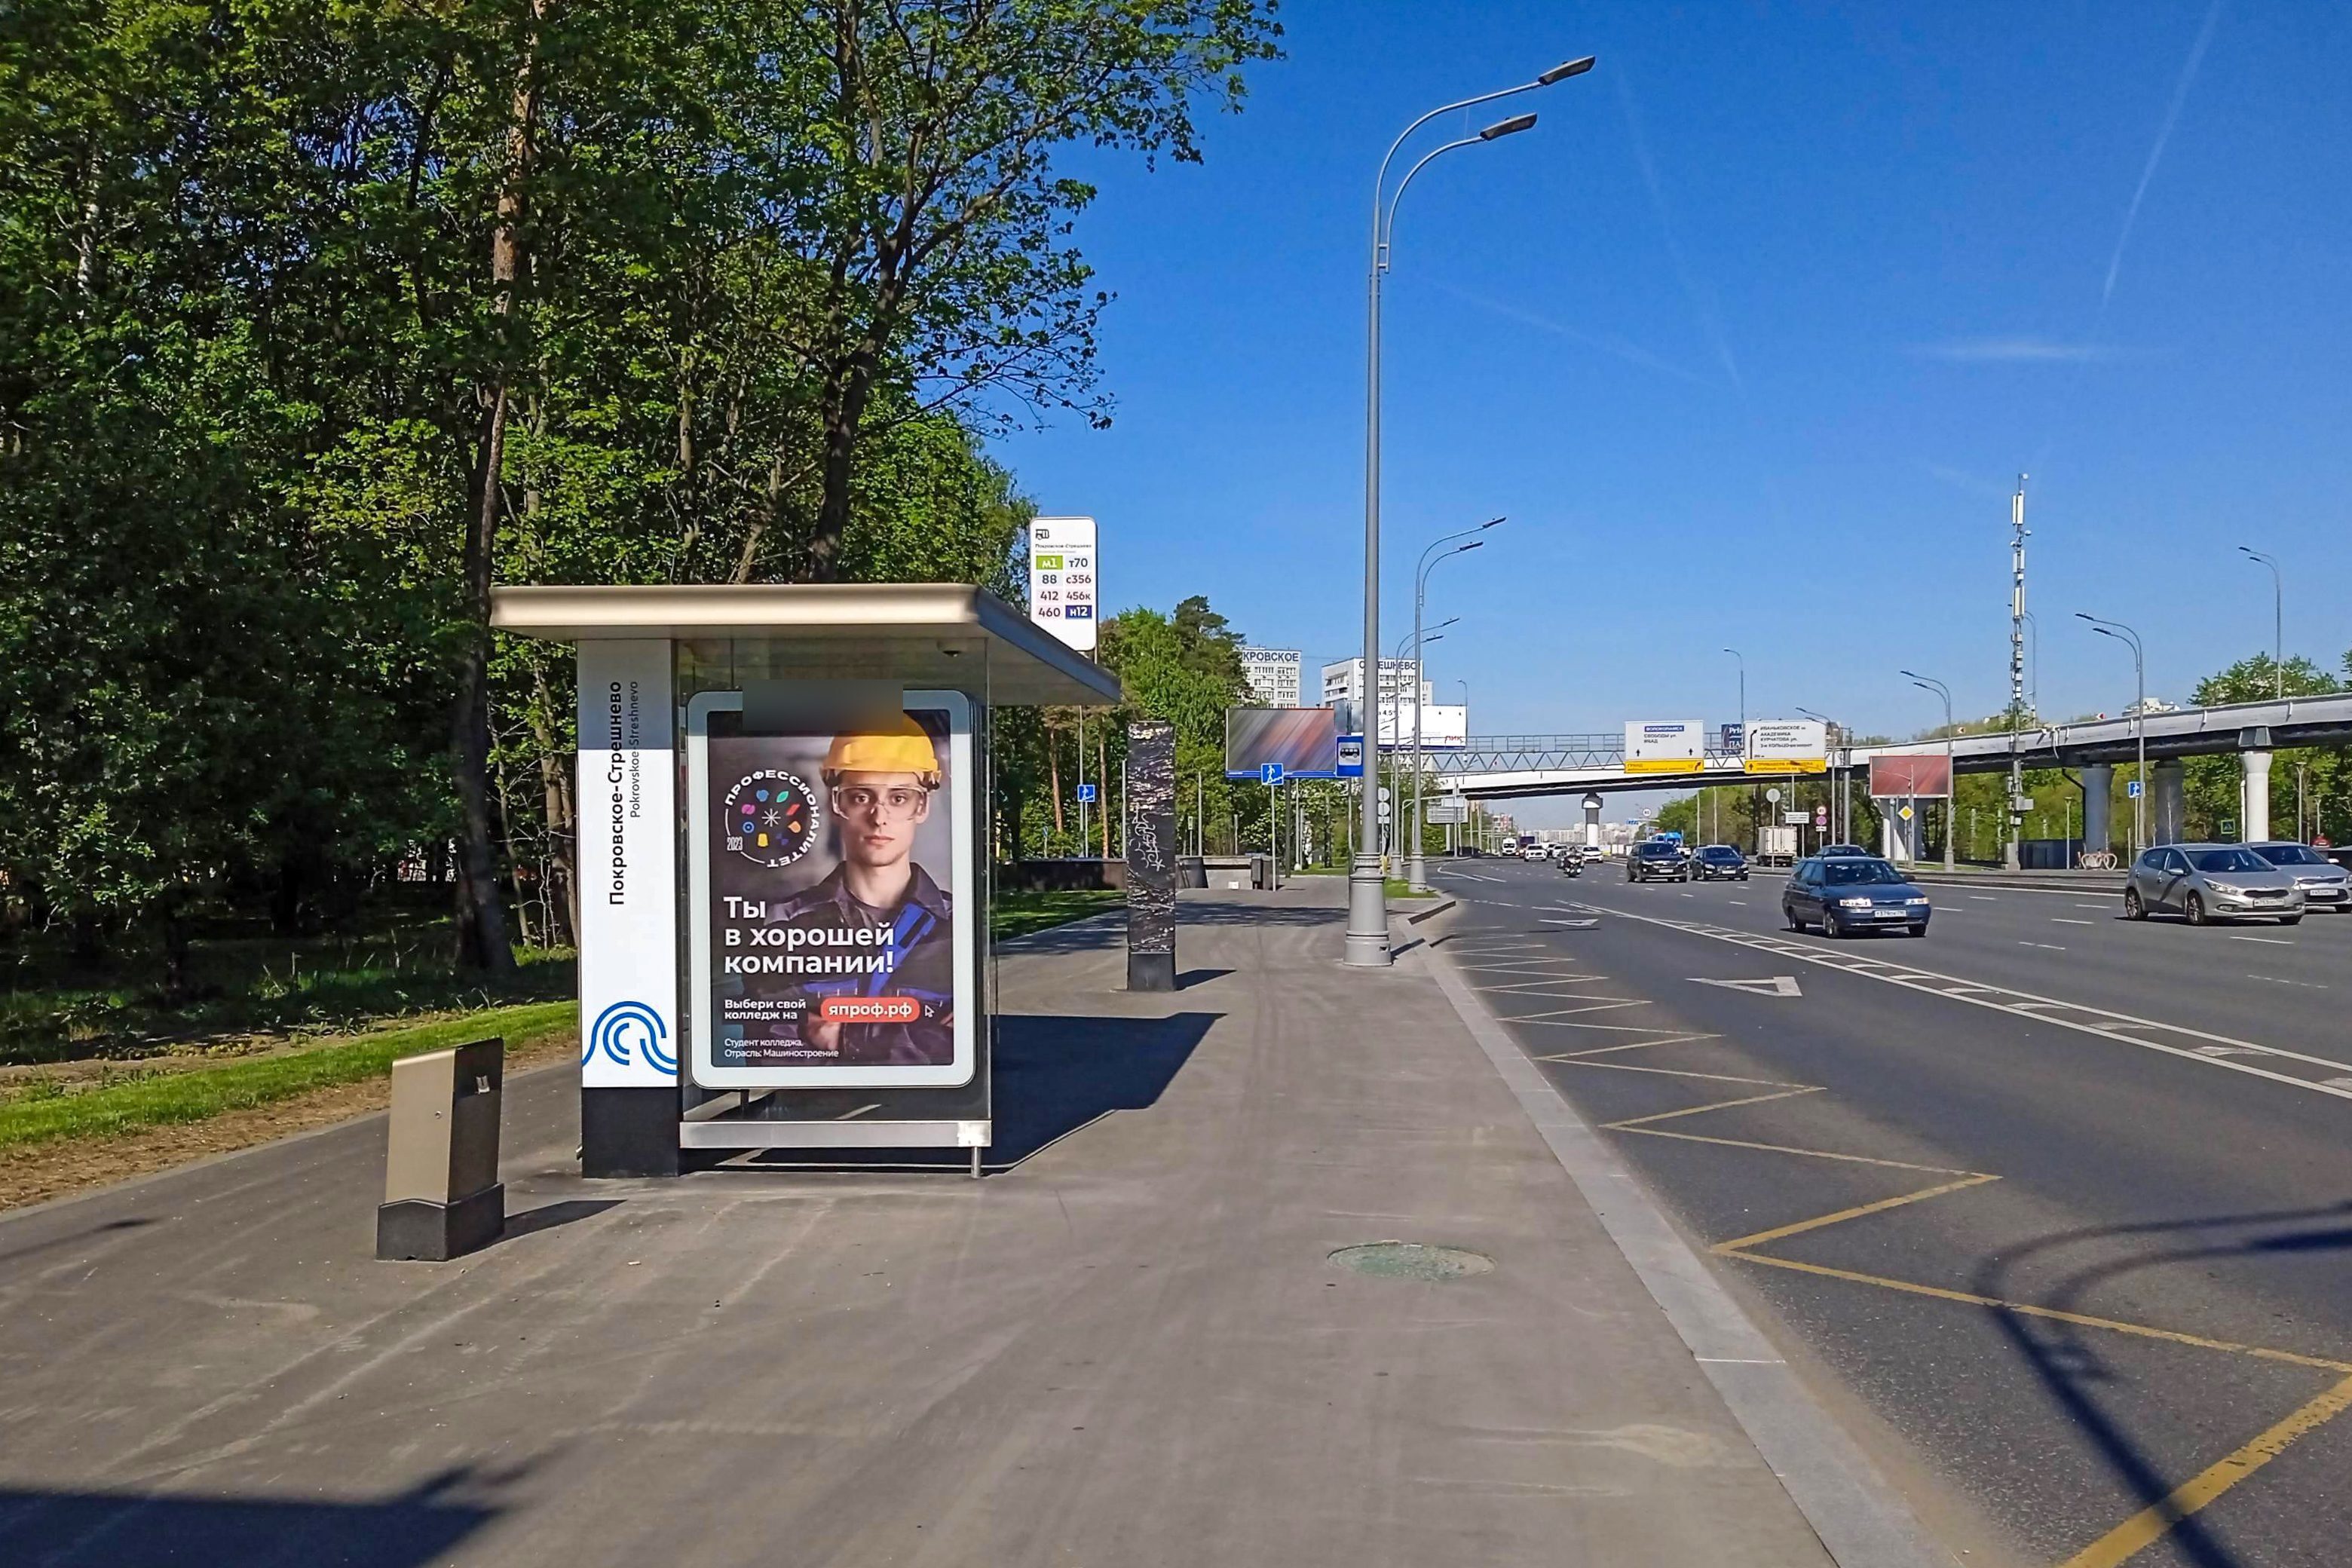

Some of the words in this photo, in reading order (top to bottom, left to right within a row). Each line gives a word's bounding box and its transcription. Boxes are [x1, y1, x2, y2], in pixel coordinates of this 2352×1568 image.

[1069, 559, 1088, 568] т70
[1042, 574, 1057, 584] 88
[1066, 575, 1092, 584] с356
[1040, 591, 1058, 601] 412
[1039, 608, 1061, 617] 460
[628, 681, 639, 818] Pokrovskoe-Streshnevo
[608, 681, 626, 905] Покровское-Стрешнево
[724, 770, 819, 868] ПРОФЕССИОНАЛИТЕТ
[727, 837, 743, 851] 2023
[724, 896, 766, 918] Ты
[725, 929, 741, 946] в
[749, 922, 893, 951] хорошей
[724, 951, 893, 973] компании!
[724, 1000, 773, 1010] Выбери
[776, 999, 807, 1009] свой
[828, 1002, 912, 1018] япроф.рф
[724, 1010, 779, 1021] колледж
[782, 1011, 798, 1019] на
[724, 1038, 759, 1048] Студент
[763, 1049, 839, 1058] Машиностроение
